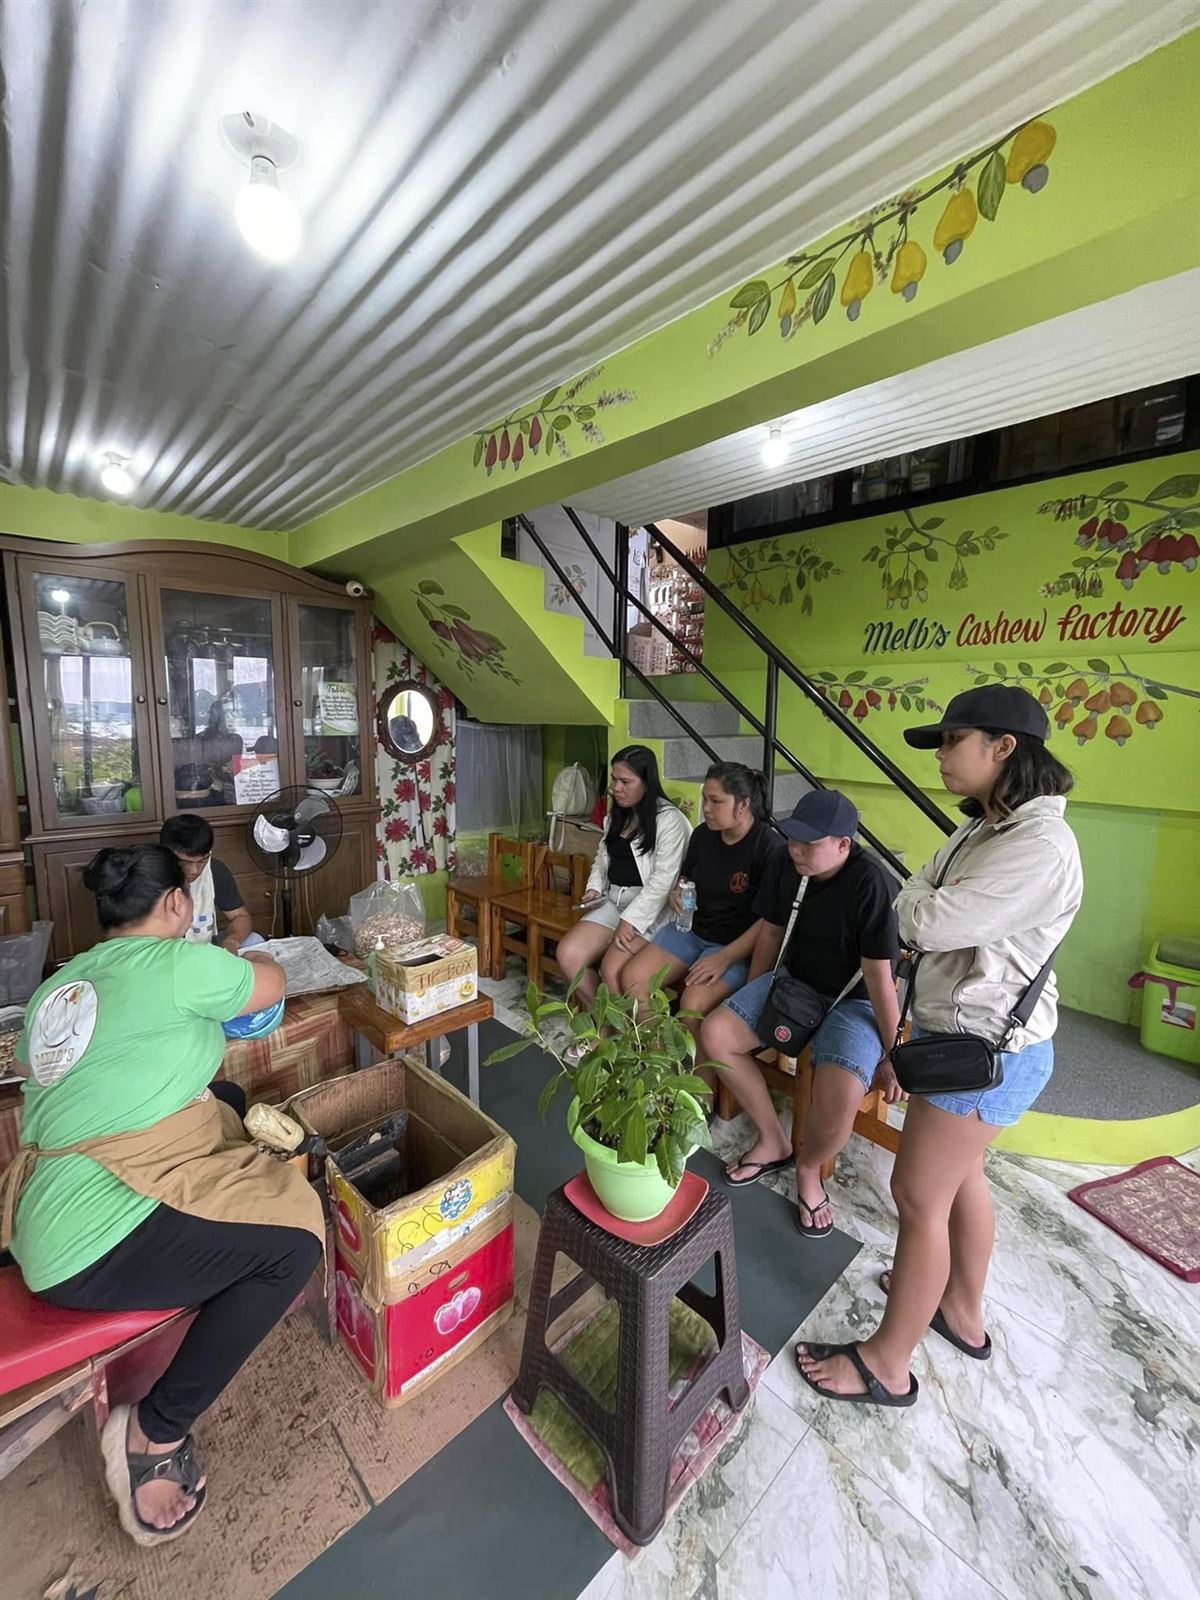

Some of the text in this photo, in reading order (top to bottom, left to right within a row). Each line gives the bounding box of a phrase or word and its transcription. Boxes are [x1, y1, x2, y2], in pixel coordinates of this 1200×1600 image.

[863, 617, 950, 653] Melb's
[956, 607, 1047, 647] Cashew
[415, 959, 473, 989] TIP BOX
